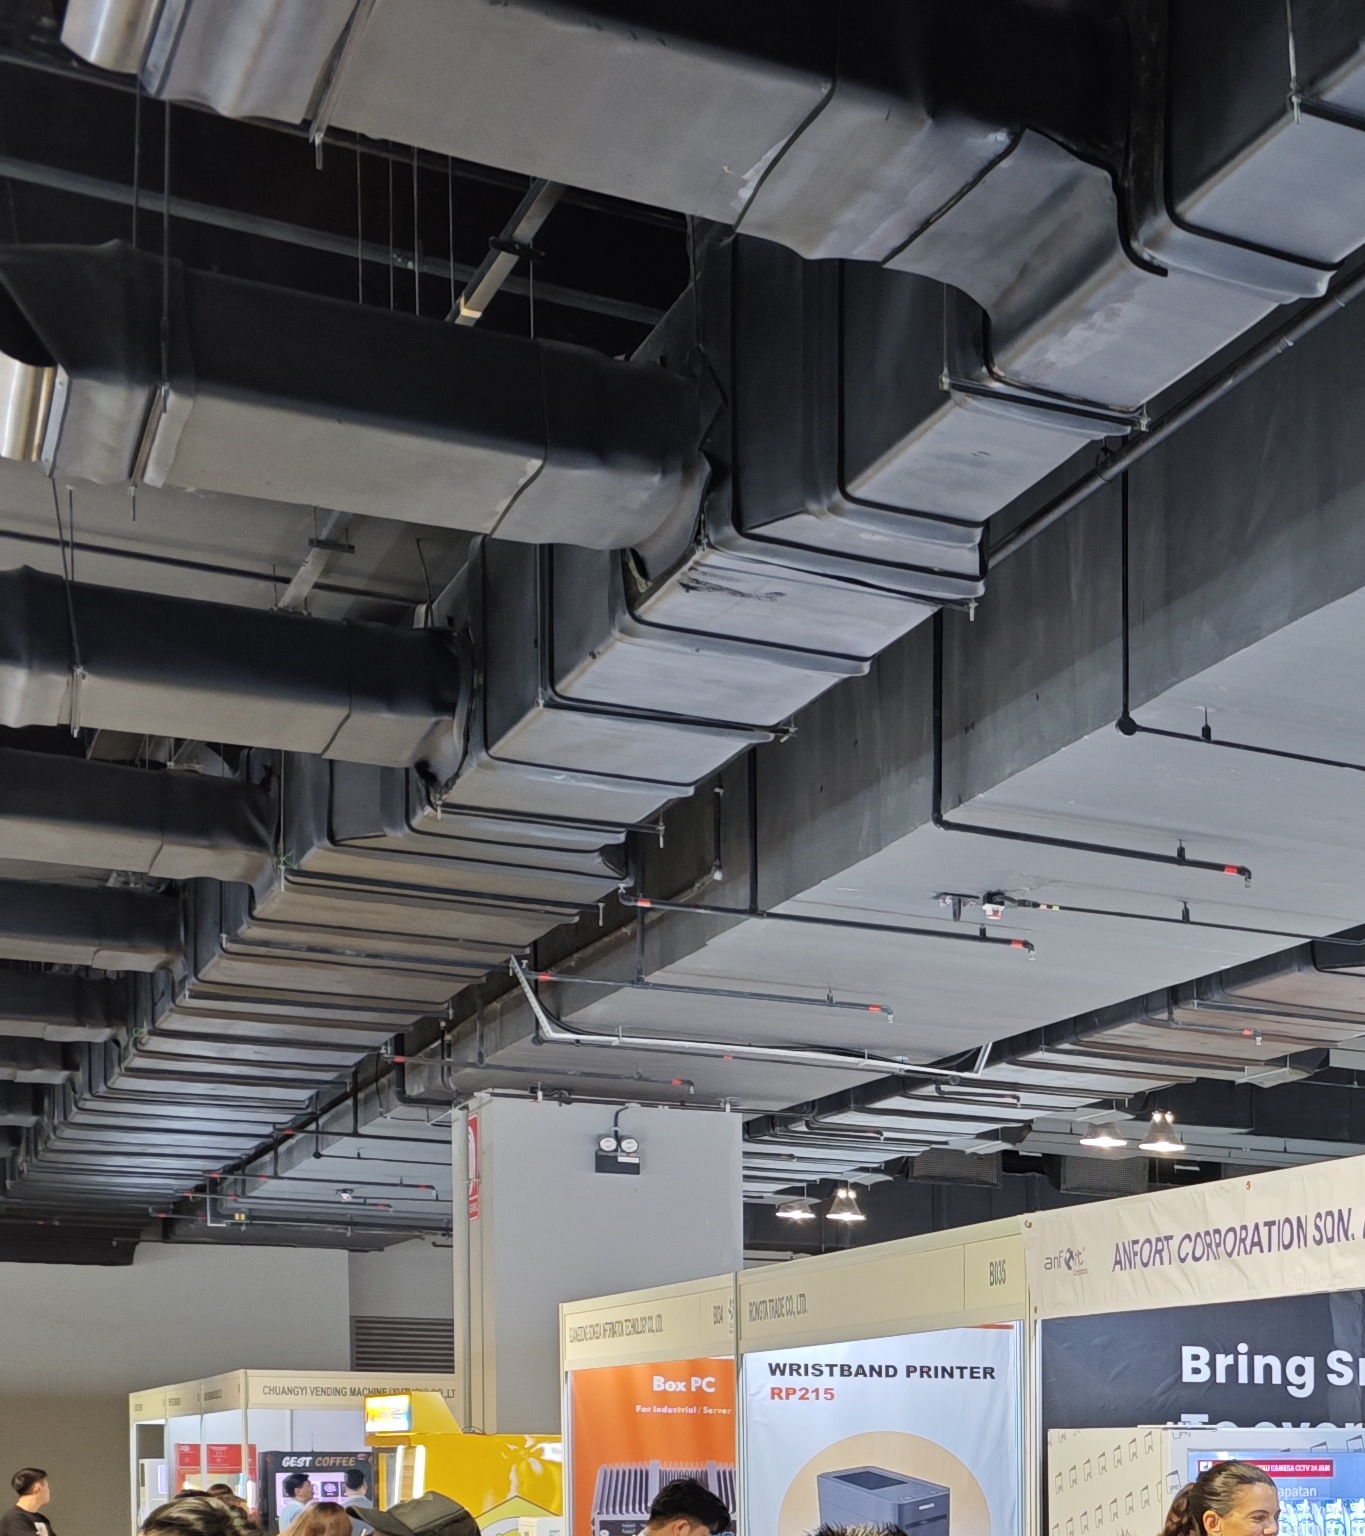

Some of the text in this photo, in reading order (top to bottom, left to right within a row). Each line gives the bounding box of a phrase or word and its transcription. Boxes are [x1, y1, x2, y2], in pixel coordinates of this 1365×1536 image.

[1111, 1234, 1175, 1273] ANFORT
[1177, 1214, 1309, 1265] CORPORATION
[1312, 1206, 1356, 1247] SDN.
[768, 1362, 996, 1380] WRISTBAND PRINTER
[1181, 1342, 1316, 1398] Bring
[262, 1384, 388, 1397] CHUANGYI VENDING MACHINE
[652, 1375, 716, 1393] Box PC
[770, 1386, 835, 1401] RP215
[314, 1455, 357, 1468] COFFEE
